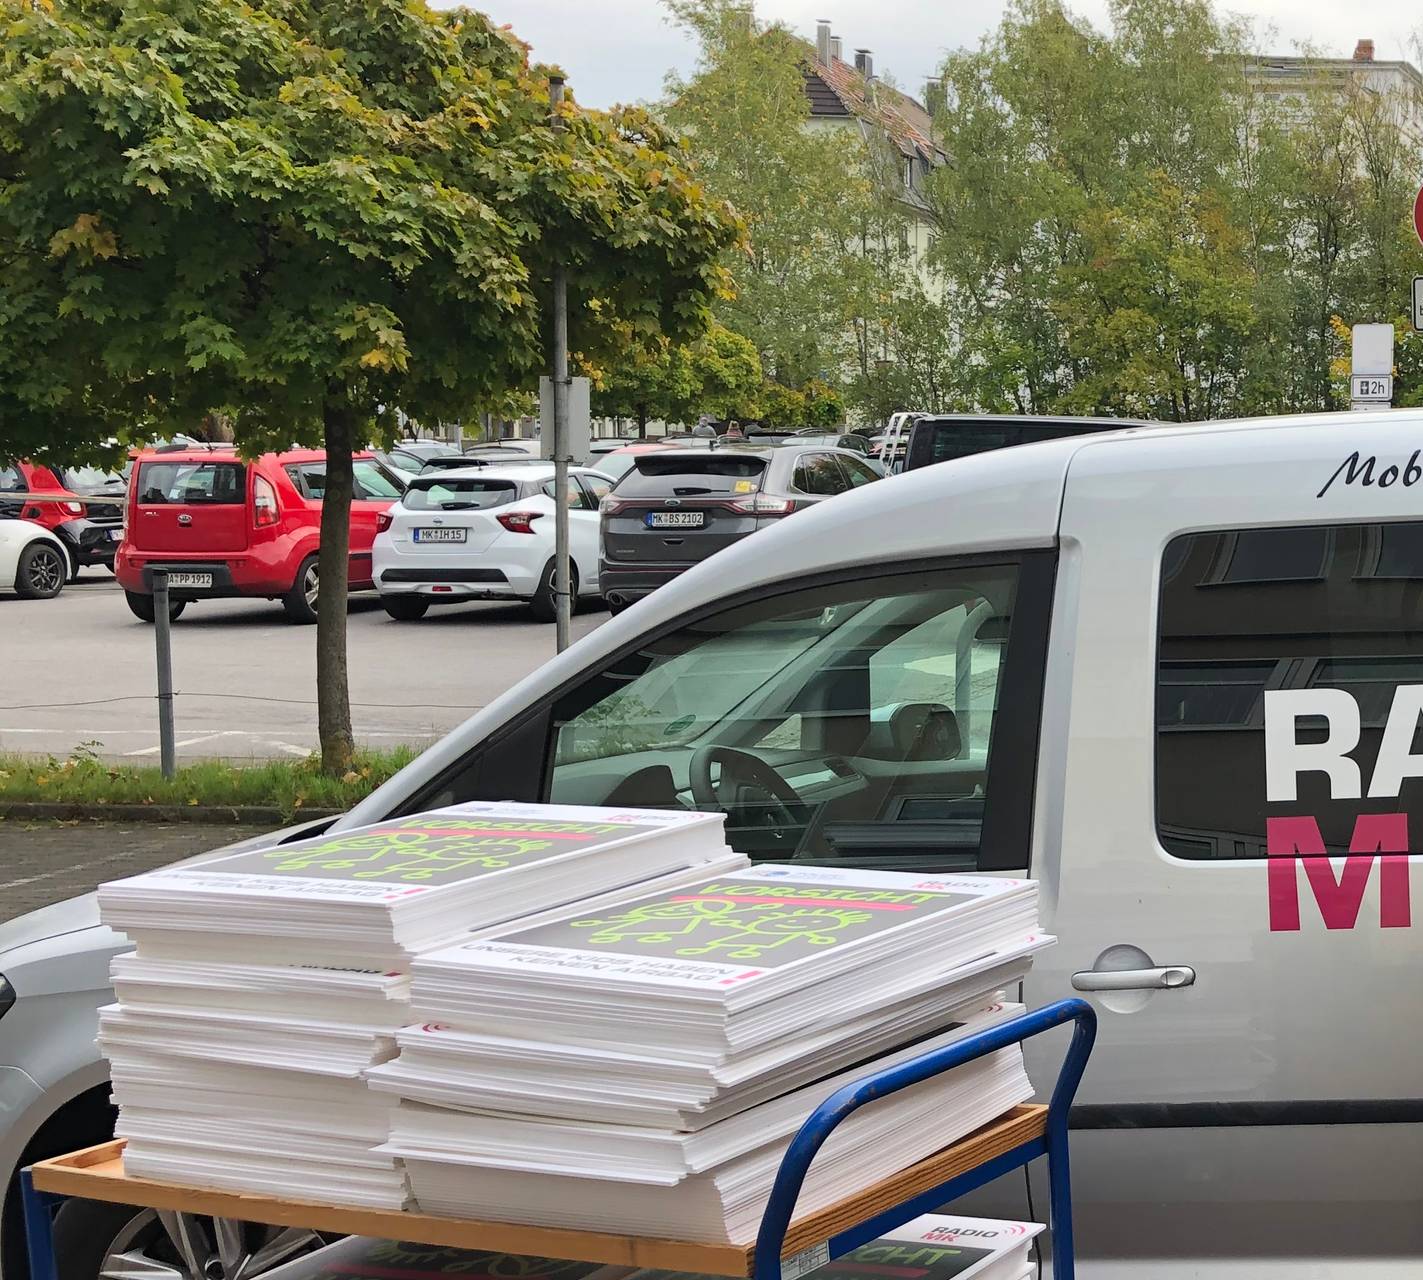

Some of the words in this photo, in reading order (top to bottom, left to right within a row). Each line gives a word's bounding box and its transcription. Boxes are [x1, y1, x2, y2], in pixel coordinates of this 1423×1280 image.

[1371, 381, 1385, 394] 2h
[653, 514, 664, 523] MK
[669, 514, 679, 523] BS
[682, 514, 703, 523] 2102
[422, 530, 434, 539] MK
[451, 530, 462, 539] 15
[180, 574, 190, 584] PP
[192, 574, 211, 584] 1912
[400, 819, 636, 834] VORSICHT
[700, 884, 950, 903] VORSICHT
[920, 1232, 960, 1242] MK
[931, 1226, 999, 1238] RADIO
